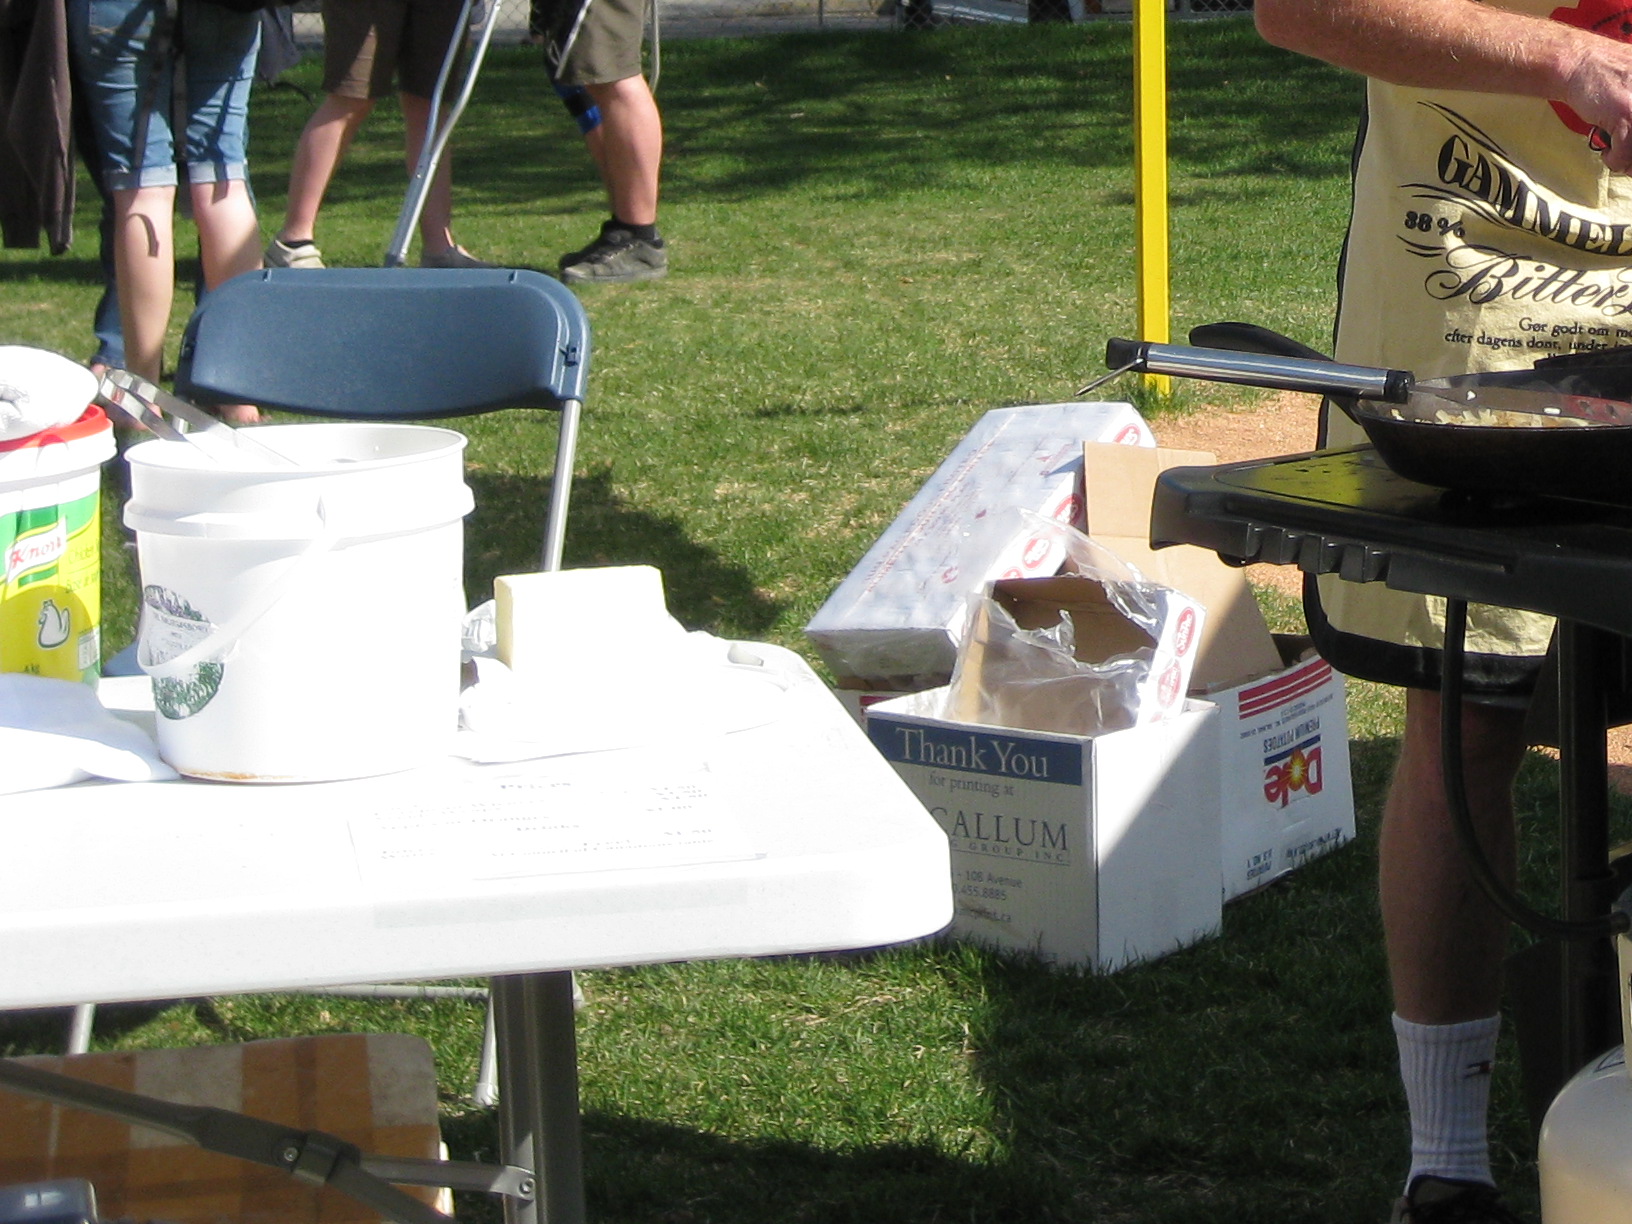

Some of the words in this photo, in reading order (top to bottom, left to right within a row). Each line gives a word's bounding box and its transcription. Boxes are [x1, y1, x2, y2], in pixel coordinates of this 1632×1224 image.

[1424, 243, 1628, 307] Bitter
[1444, 328, 1474, 344] efter
[1477, 331, 1523, 349] dagens
[1551, 322, 1584, 338] godt
[1588, 326, 1610, 337] om
[895, 727, 988, 771] Thank
[990, 739, 1049, 778] You
[1264, 731, 1295, 754] POTATOES
[928, 770, 945, 787] for
[949, 776, 1000, 798] printing
[1003, 785, 1015, 796] at
[1263, 746, 1324, 810] Dole
[968, 841, 1024, 857] GROUP
[987, 872, 1023, 889] Avenue
